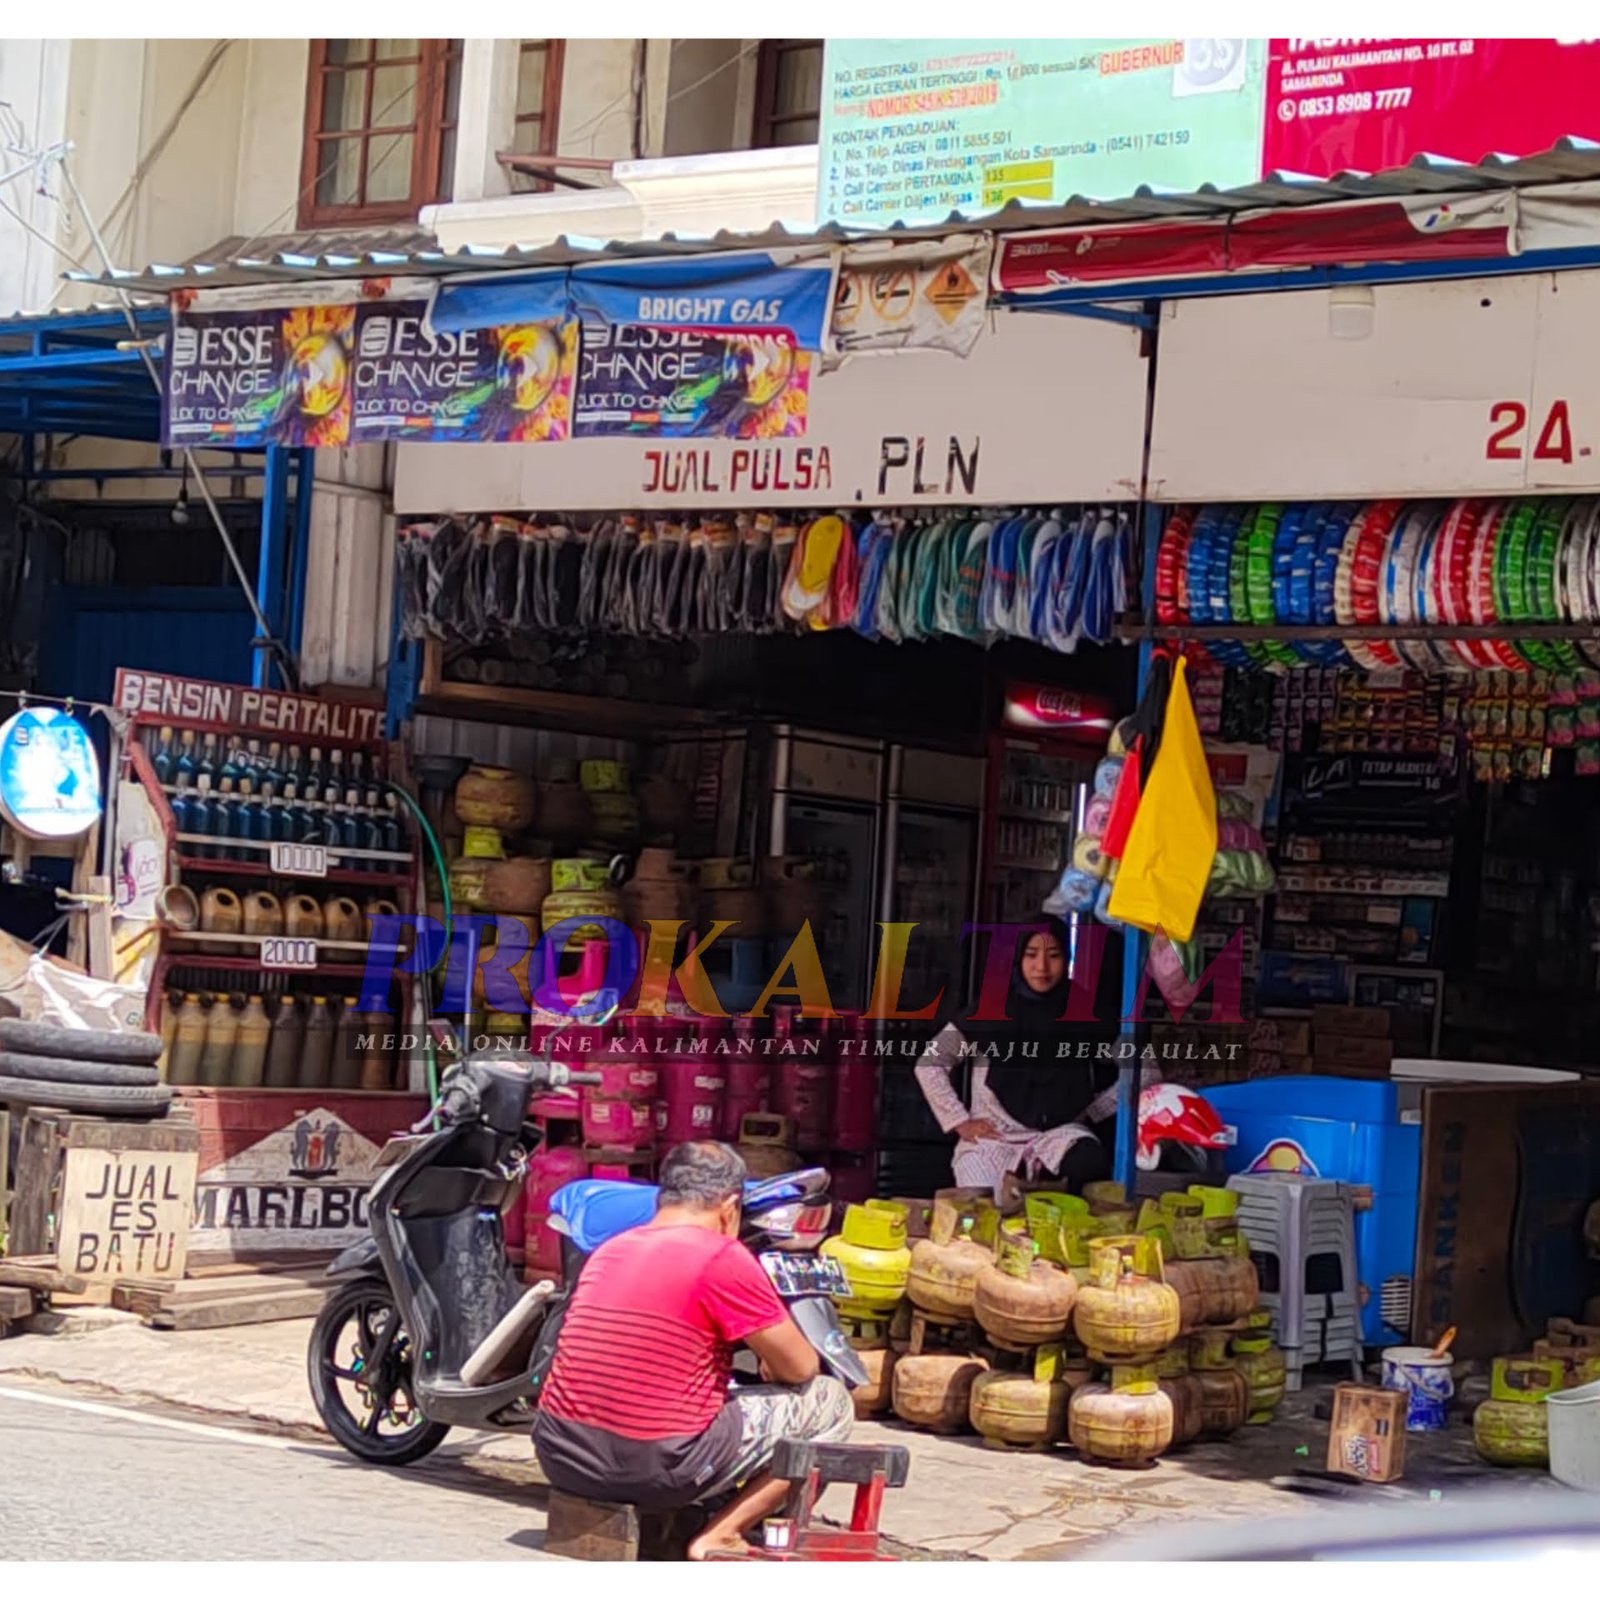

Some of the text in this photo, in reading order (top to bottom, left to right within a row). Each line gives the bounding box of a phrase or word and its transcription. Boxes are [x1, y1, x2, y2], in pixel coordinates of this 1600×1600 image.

[834, 83, 870, 99] HARGA
[874, 78, 917, 95] ECERAN
[920, 70, 977, 89] TERTINGGI
[1079, 56, 1096, 71] SK
[1100, 42, 1184, 75] GUBERNUR
[856, 63, 918, 80] REGISTRASI
[1297, 56, 1330, 73] PULAU
[1333, 48, 1402, 69] KALIMANTAN
[1281, 72, 1344, 93] SAMARINDA
[1299, 87, 1412, 117] 0853 8908 7777
[832, 118, 959, 145] KONTAK PENGADUAN:
[846, 147, 862, 161] No.
[892, 140, 927, 156] AGEN
[892, 158, 924, 174] Dinas
[1003, 146, 1030, 162] Kota
[1033, 140, 1097, 160] Samarinda
[1104, 134, 1143, 155] (0541)
[843, 181, 864, 197] Call
[866, 178, 902, 195] Center
[904, 171, 974, 191] PERTAMINA
[842, 199, 862, 214] Call
[865, 196, 901, 212] Center
[939, 190, 973, 208] Migas
[639, 297, 783, 323] BRIGHT GAS
[200, 325, 275, 365] ESSE
[354, 360, 477, 398] CHANGE
[580, 351, 703, 389] CHANGE
[169, 368, 273, 404] CHANGE
[198, 406, 217, 421] TO
[218, 404, 265, 425] CHANGE
[389, 398, 411, 413] TO
[412, 398, 470, 417] CHANGE
[611, 392, 635, 409] TO
[638, 392, 699, 411] CHANGE
[642, 449, 720, 493] JUAL
[730, 445, 833, 492] PULSA
[120, 673, 387, 741] BENSIN PERTALITE
[276, 843, 325, 875] 10000
[264, 939, 317, 965] 20000
[85, 1163, 182, 1201] JUAL
[109, 1202, 159, 1231] ES
[75, 1233, 177, 1275] BATU
